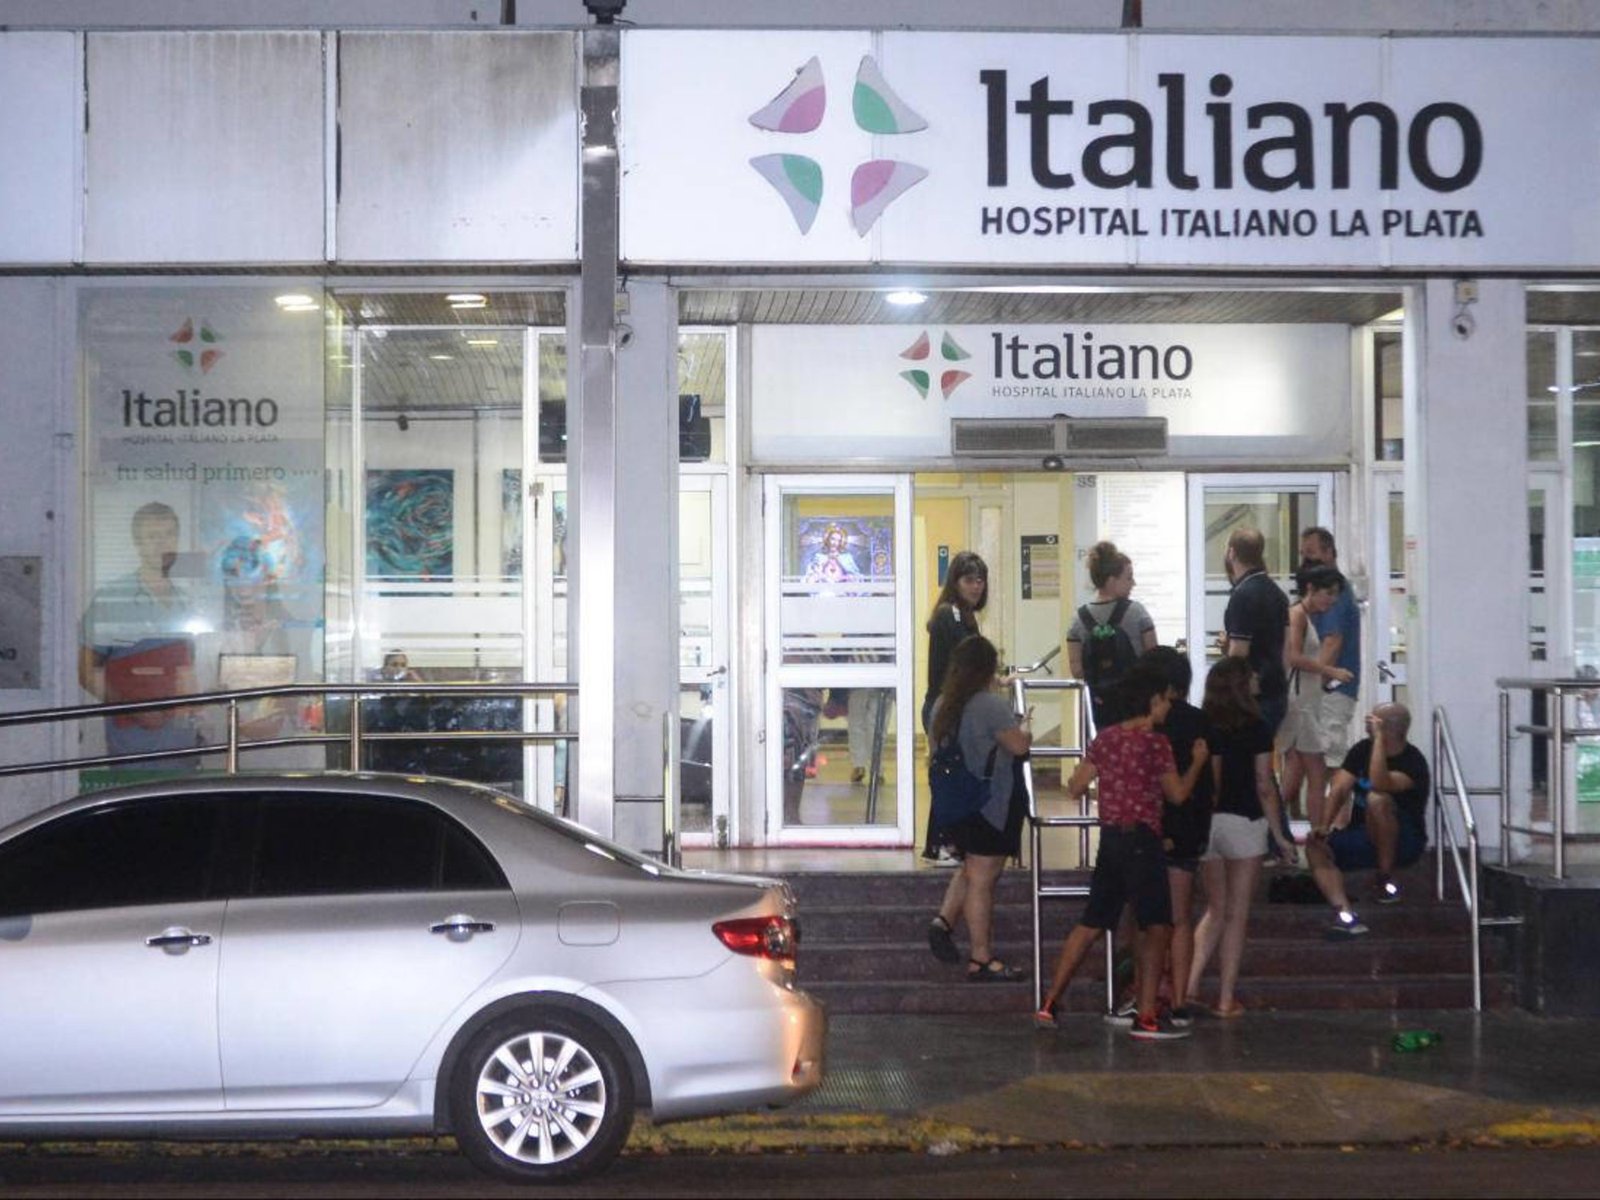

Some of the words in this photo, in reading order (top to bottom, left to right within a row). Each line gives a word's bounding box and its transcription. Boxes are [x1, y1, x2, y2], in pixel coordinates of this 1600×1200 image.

[980, 69, 1483, 192] Italiano
[981, 206, 1148, 236] HOSPITAL
[1160, 208, 1318, 238] ITALIANO
[1330, 209, 1370, 237] LA
[1383, 209, 1485, 238] PLATA
[991, 331, 1192, 380] Italiano
[122, 389, 278, 427] Italiano
[992, 386, 1057, 398] HOSPITAL
[1063, 386, 1126, 398] ITALIANO
[1131, 386, 1147, 398] LA
[1152, 387, 1192, 399] PLATA
[117, 463, 137, 481] tu
[143, 462, 197, 481] salud
[203, 462, 286, 484] primero
